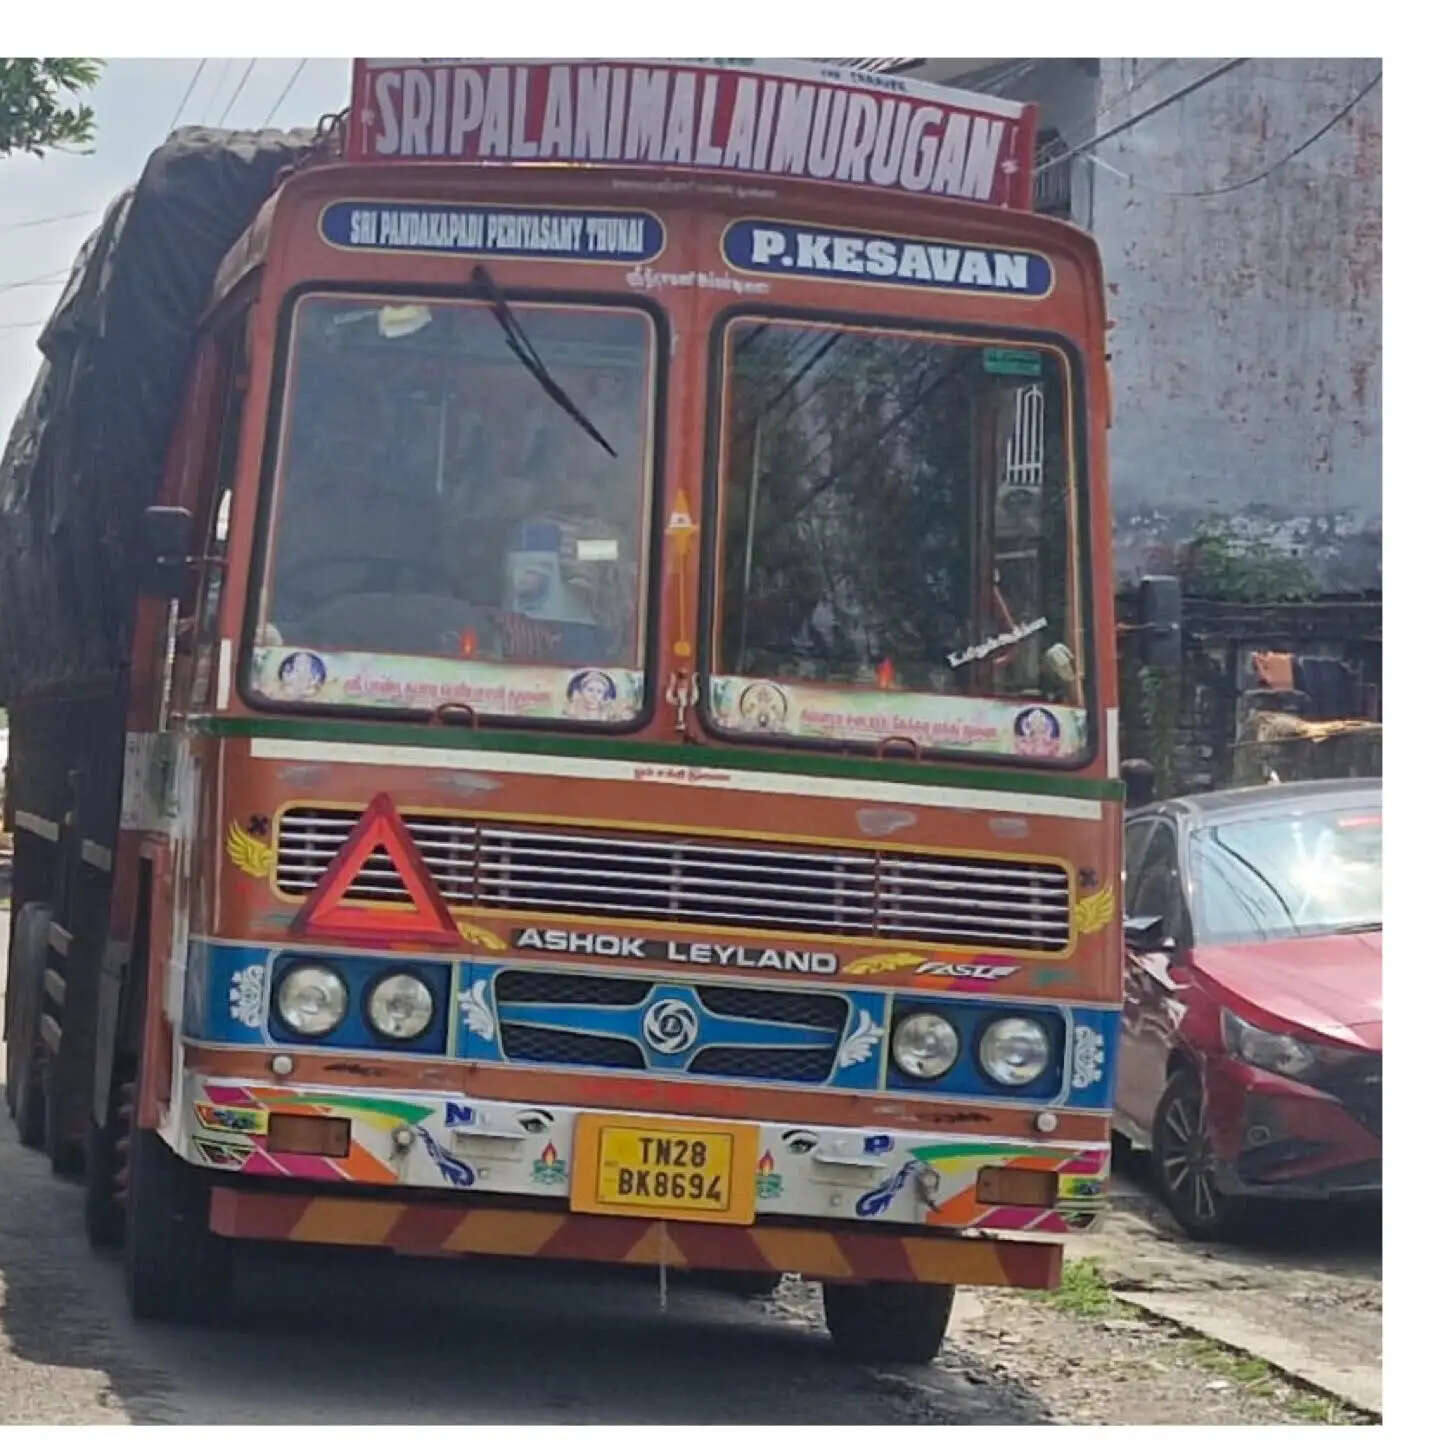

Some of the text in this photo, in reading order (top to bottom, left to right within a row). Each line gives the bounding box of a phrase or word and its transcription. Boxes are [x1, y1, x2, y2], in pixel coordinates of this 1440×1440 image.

[351, 210, 378, 245] SRI
[585, 217, 645, 253] THUNAI
[751, 228, 1030, 290] P.KESAVAN
[517, 927, 838, 975] ASHOK LEYLAND
[638, 1137, 707, 1168] TN28
[618, 1168, 721, 1201] BK8694
